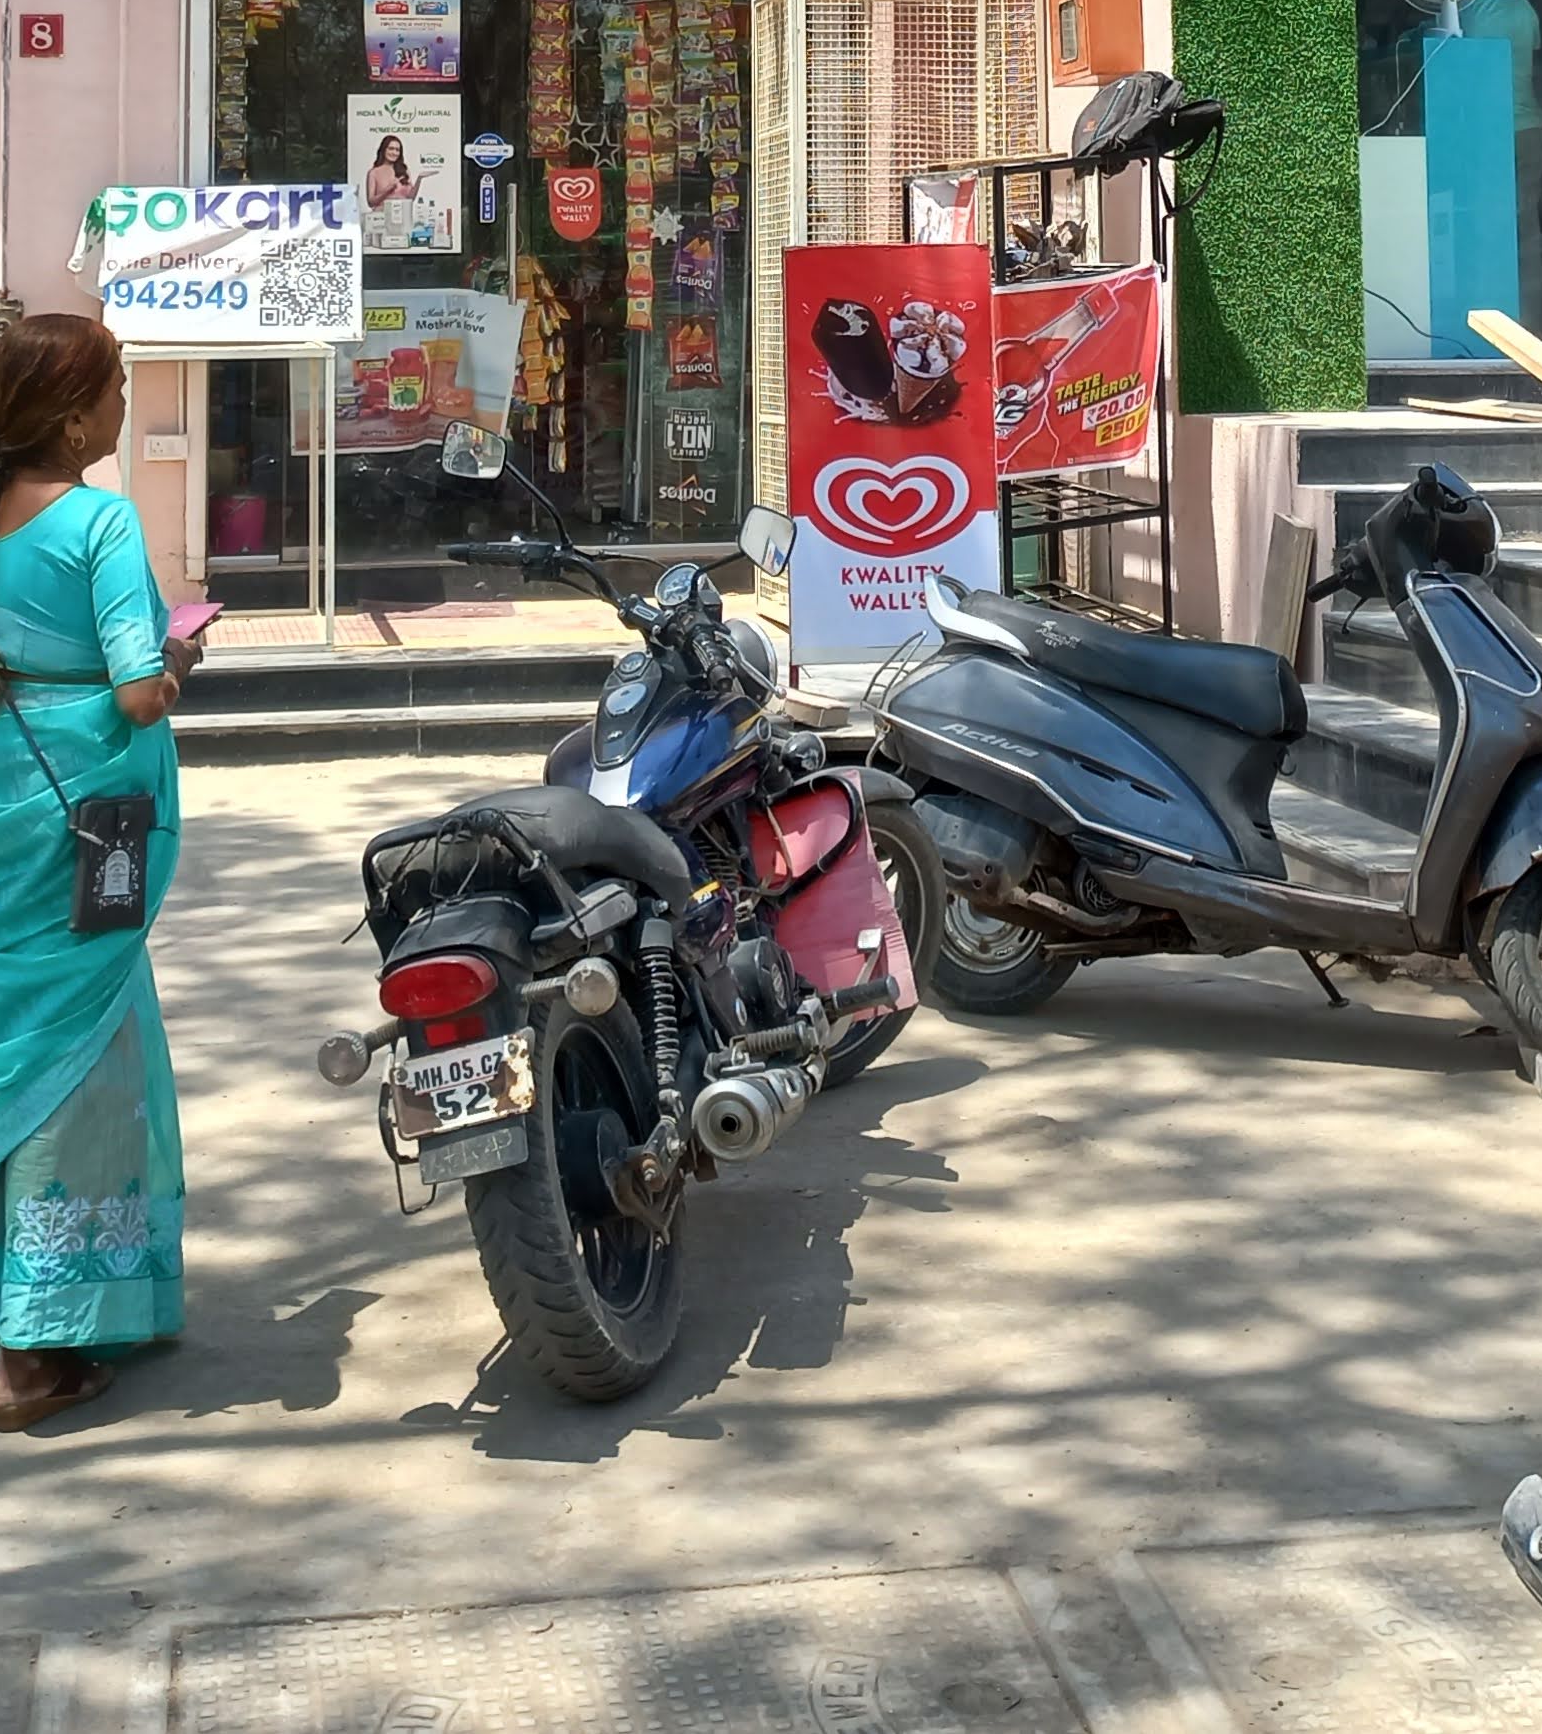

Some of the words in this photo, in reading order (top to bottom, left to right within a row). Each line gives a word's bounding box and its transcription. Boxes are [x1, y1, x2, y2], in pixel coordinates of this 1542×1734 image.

[30, 21, 54, 51] 8
[159, 252, 245, 274] Delivery
[463, 320, 485, 334] love
[1055, 372, 1102, 402] TASTE
[1057, 397, 1079, 416] THE
[1080, 372, 1141, 407] ENERGY
[666, 423, 712, 449] NO.1
[658, 485, 716, 504] Doritos
[841, 564, 945, 586] KWALITY
[848, 591, 928, 612] WALL'S
[939, 722, 1040, 759] Activa
